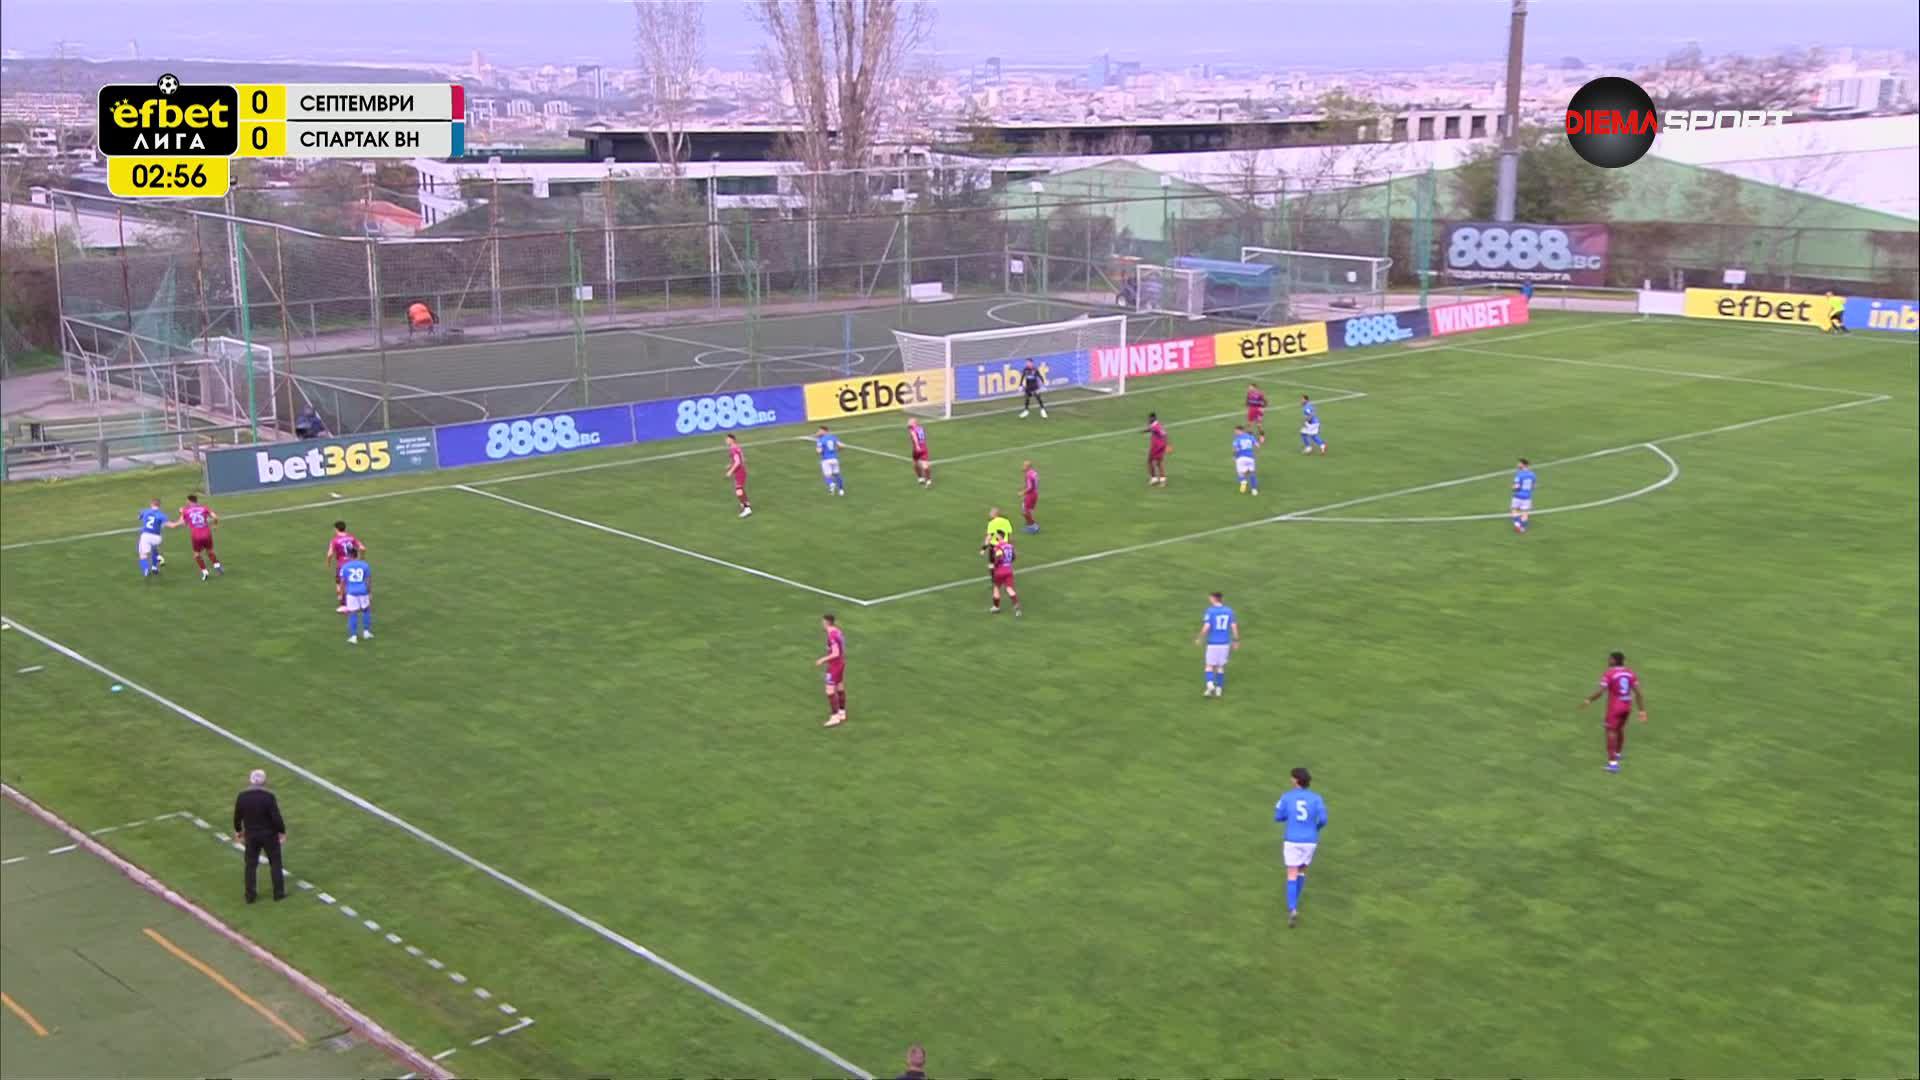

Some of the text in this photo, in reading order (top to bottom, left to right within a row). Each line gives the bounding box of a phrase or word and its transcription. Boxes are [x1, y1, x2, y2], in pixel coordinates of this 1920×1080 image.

[1435, 299, 1511, 334] WINBET
[1717, 295, 1811, 321] efbet
[1098, 339, 1195, 378] WINBET
[1240, 331, 1308, 360] efbet
[837, 376, 929, 414] efbet
[256, 440, 391, 483] bet365
[146, 516, 155, 529] 2
[348, 567, 364, 583] 29
[1215, 614, 1229, 631] 17
[1620, 677, 1630, 695] 9
[1296, 800, 1308, 821] 5
